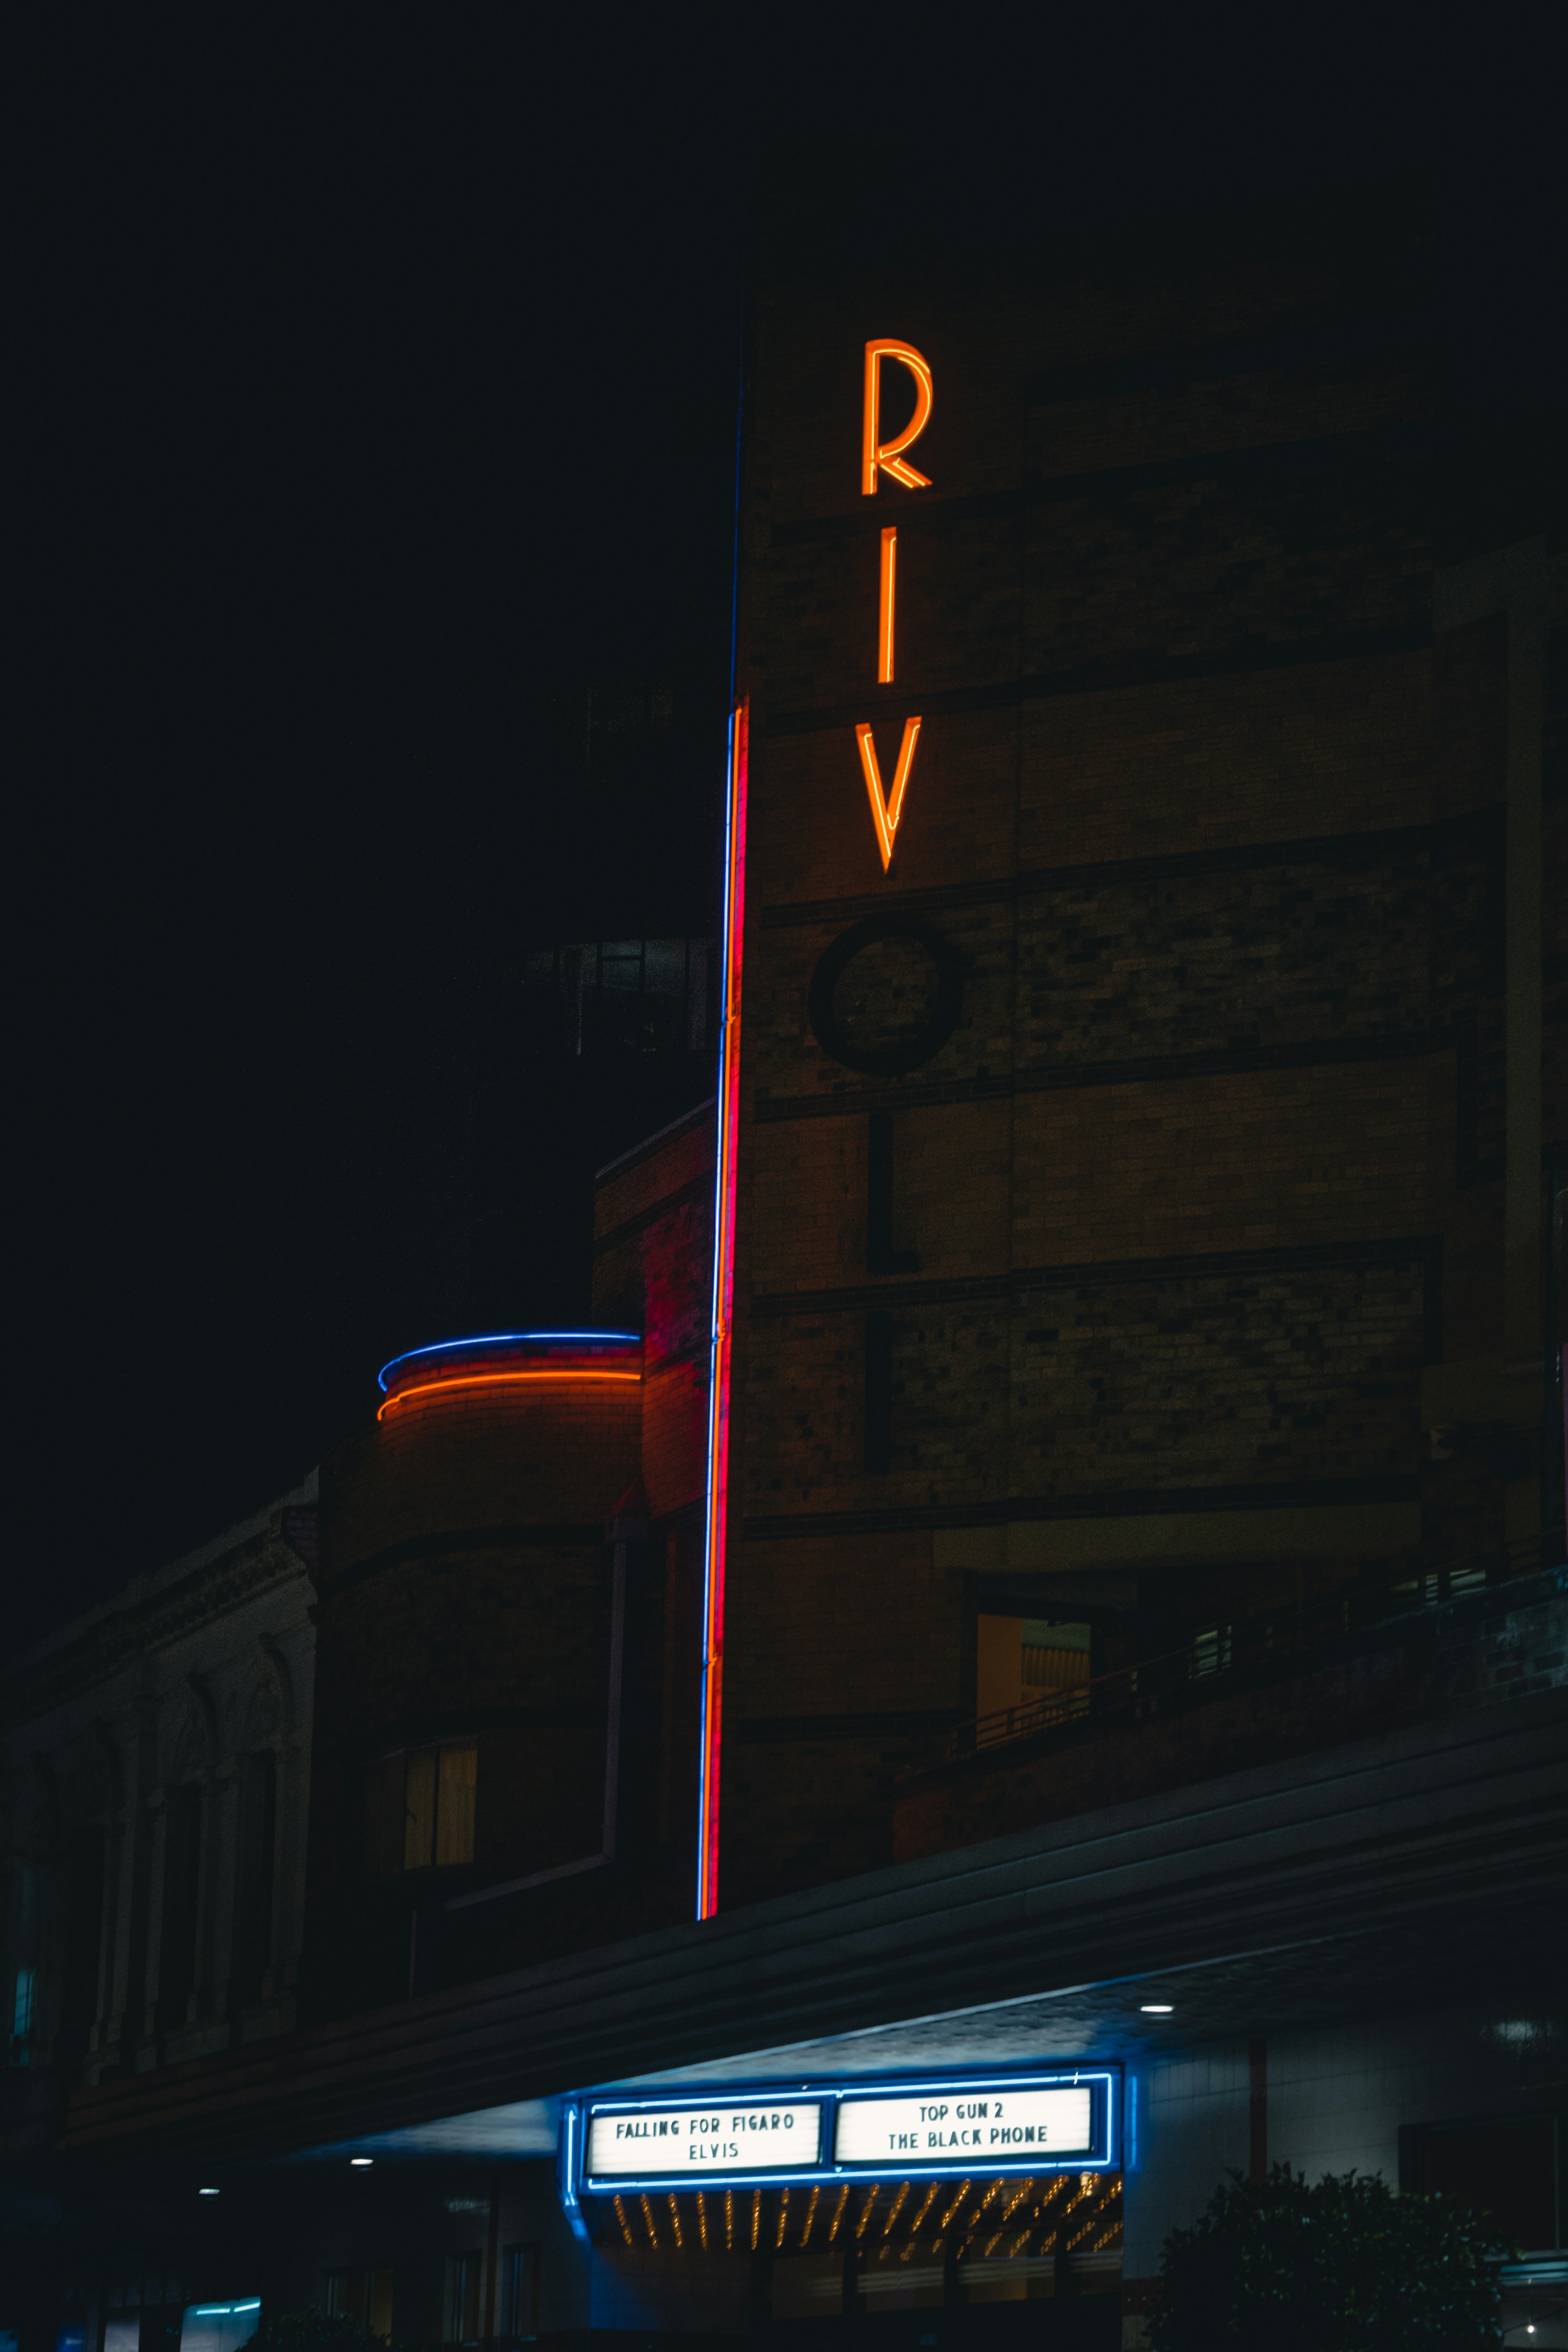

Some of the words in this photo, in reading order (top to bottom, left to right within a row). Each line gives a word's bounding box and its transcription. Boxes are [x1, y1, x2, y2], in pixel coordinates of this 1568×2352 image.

[919, 2105, 949, 2122] TOP
[956, 2102, 988, 2119] GUN
[994, 2102, 1003, 2118] 2
[616, 2120, 679, 2139] FALLING
[690, 2117, 720, 2135] FOR
[733, 2113, 794, 2132] FIGARO
[889, 2133, 919, 2150] THE
[928, 2128, 982, 2148] BLACK
[990, 2126, 1048, 2144] PHONE
[689, 2142, 738, 2160] ELVIS
